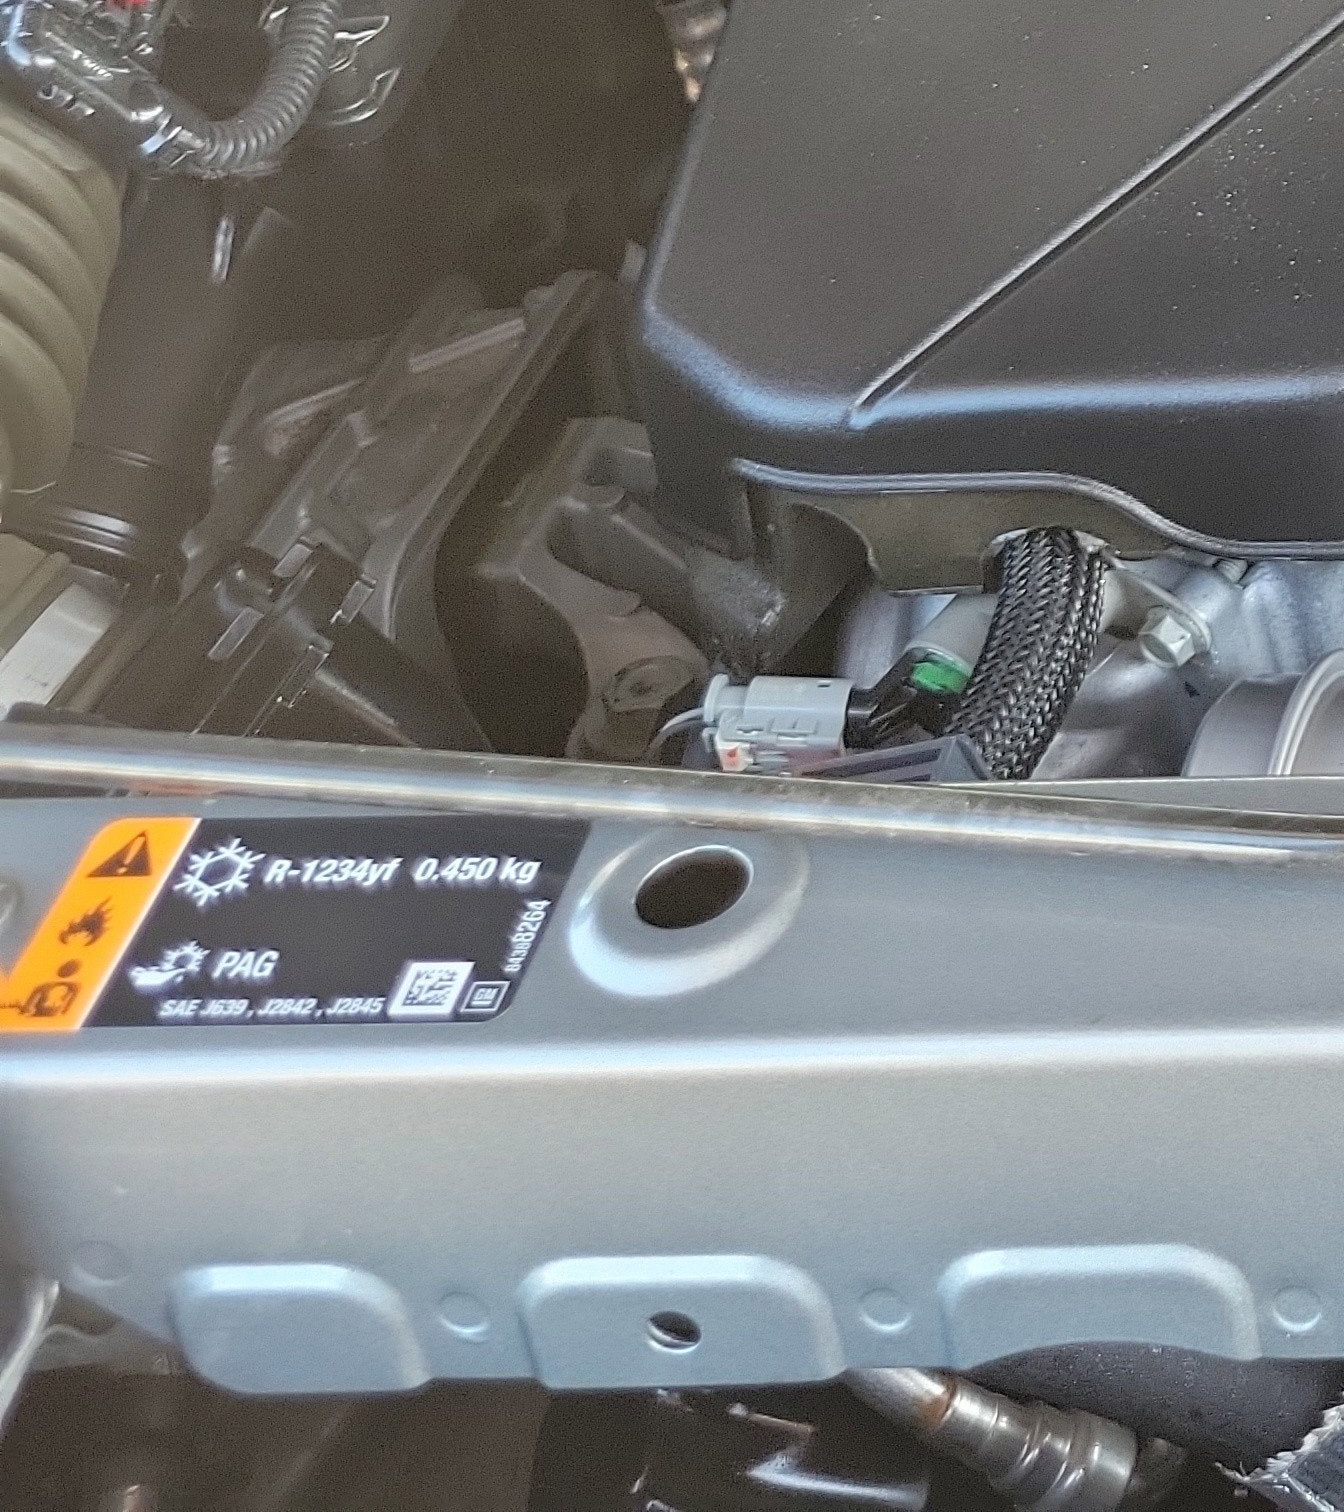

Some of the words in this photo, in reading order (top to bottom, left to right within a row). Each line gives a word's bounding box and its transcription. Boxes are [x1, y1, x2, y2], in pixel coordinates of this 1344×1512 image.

[263, 857, 403, 886] R-1234yf
[413, 857, 498, 882] 0.450
[500, 856, 542, 885] kg
[212, 950, 280, 979] PAG
[160, 998, 201, 1016] SAE
[326, 997, 386, 1015] J2845
